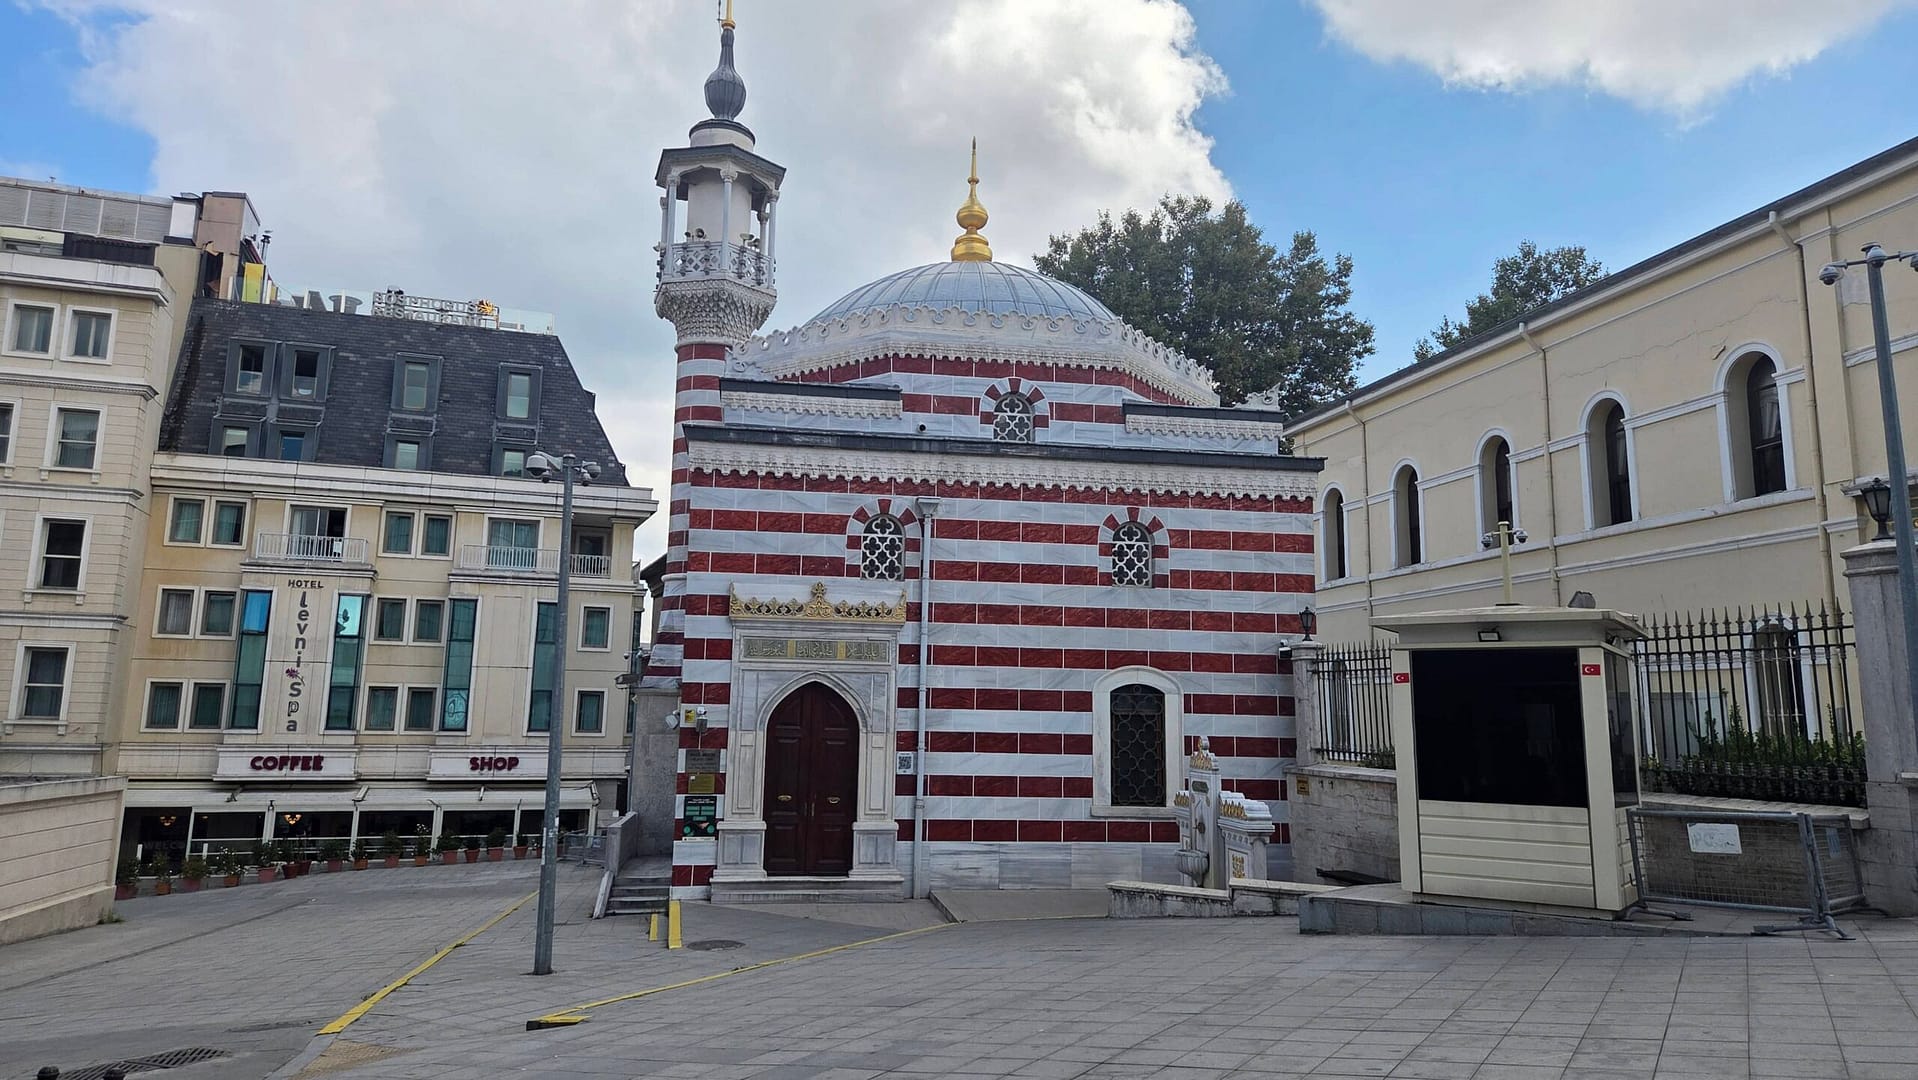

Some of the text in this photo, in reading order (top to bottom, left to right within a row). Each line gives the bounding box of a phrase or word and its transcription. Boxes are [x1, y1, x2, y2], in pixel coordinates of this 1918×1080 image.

[373, 291, 478, 313] BOSPHORUS
[371, 305, 484, 328] RESTAURANT
[288, 579, 324, 589] HOTEL
[250, 754, 520, 772] COFFEE SHOP
